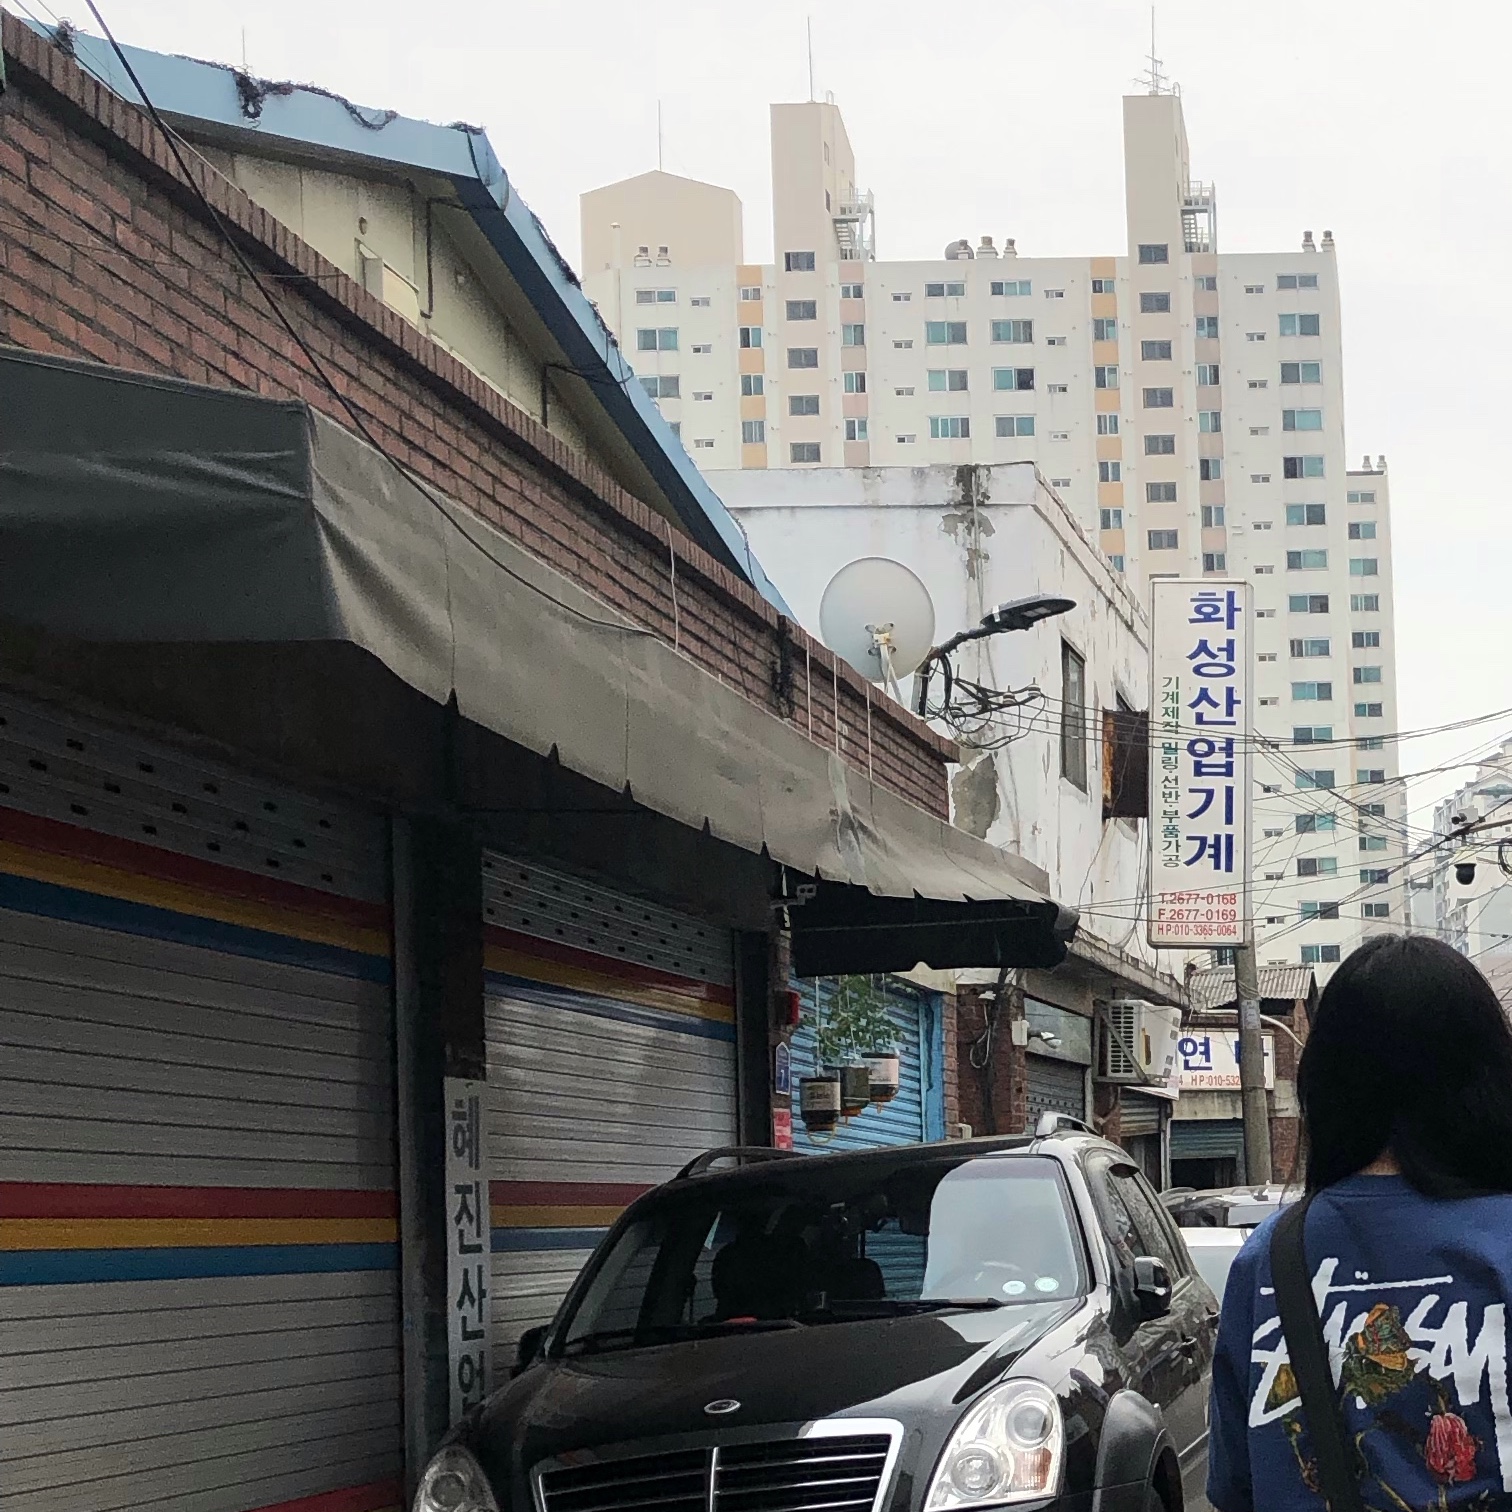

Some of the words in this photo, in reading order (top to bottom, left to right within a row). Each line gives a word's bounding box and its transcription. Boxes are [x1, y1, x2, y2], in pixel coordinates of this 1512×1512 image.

[1161, 676, 1180, 735] 기계제작
[1183, 590, 1242, 873] 화성산업기계
[1158, 908, 1237, 921] F.2677-0169
[1159, 893, 1237, 905] T.2677-0168
